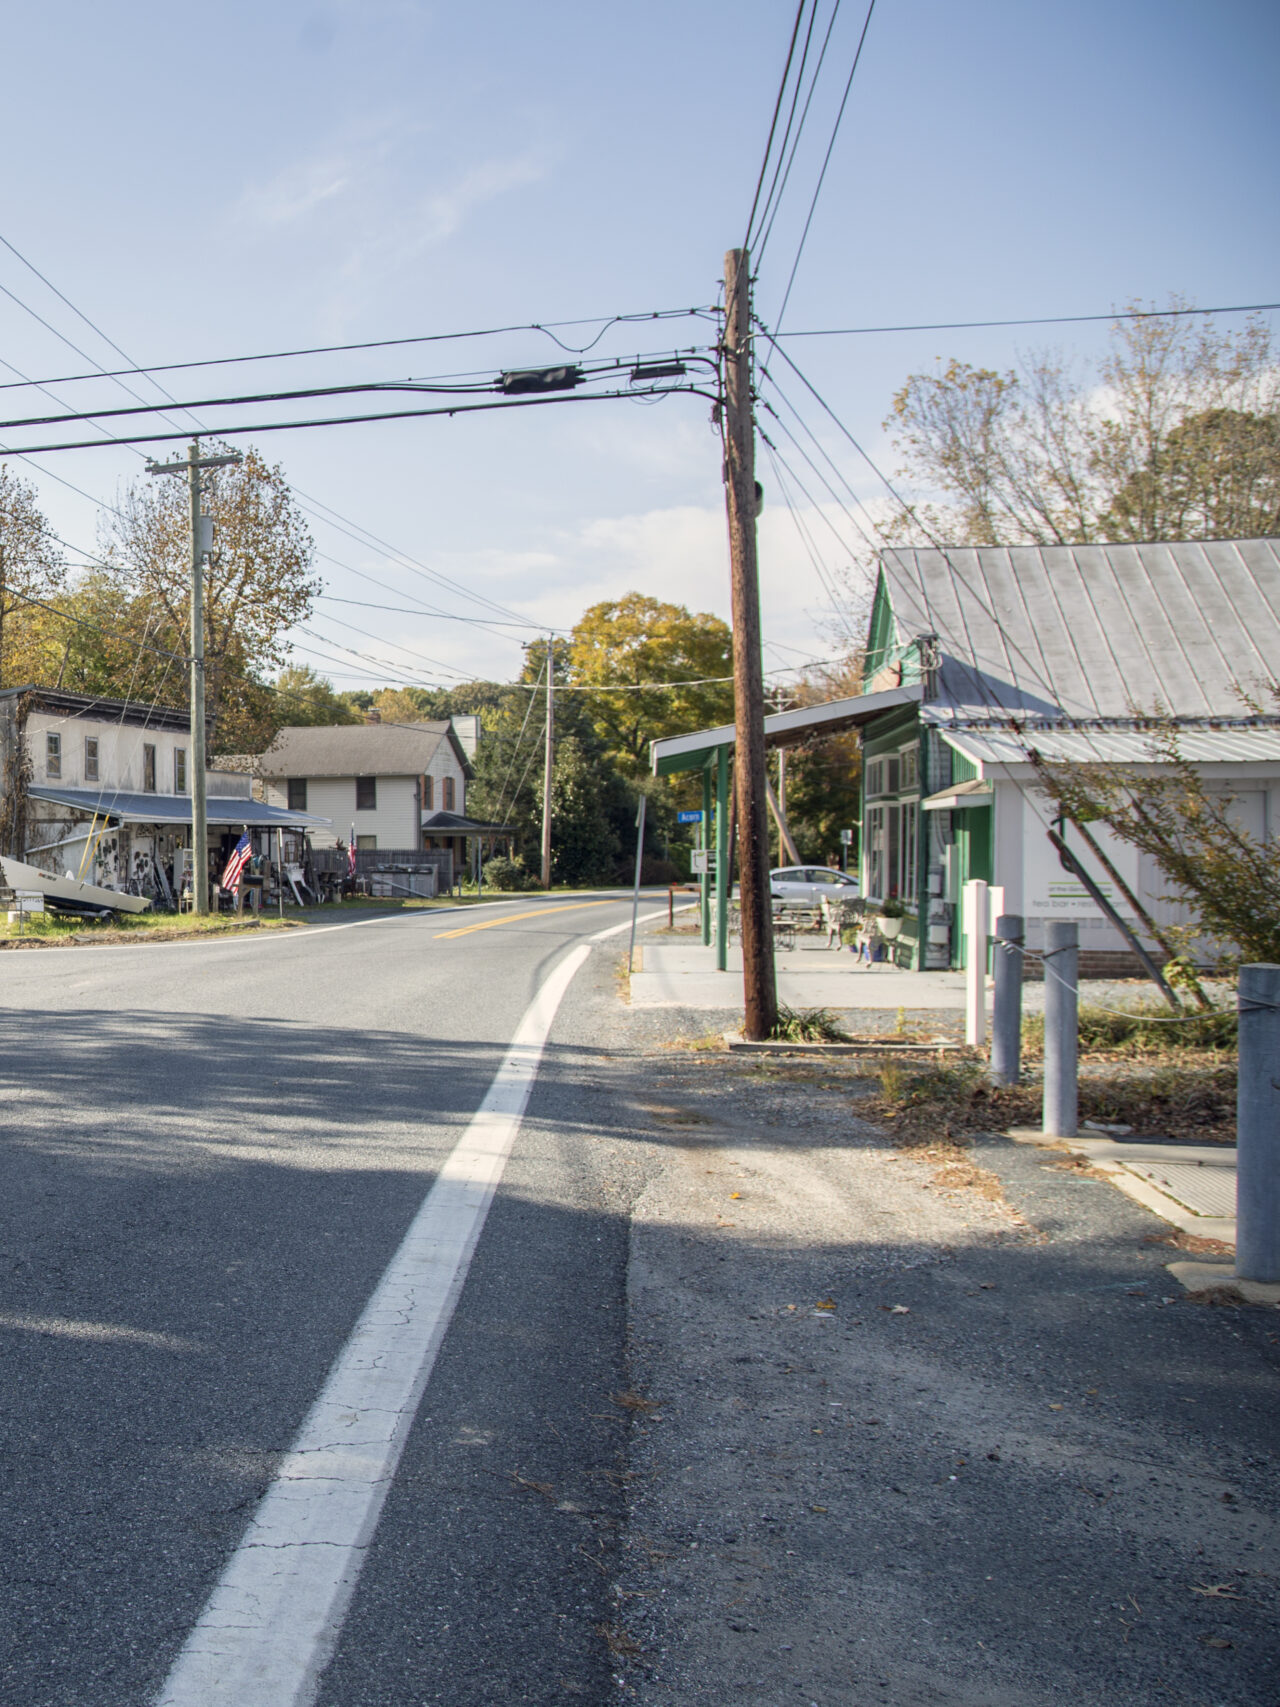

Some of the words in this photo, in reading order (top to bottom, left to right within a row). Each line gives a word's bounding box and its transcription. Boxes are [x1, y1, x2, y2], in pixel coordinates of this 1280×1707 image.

[681, 812, 700, 821] Acorn
[1032, 900, 1049, 908] tea
[1051, 900, 1069, 908] bar
